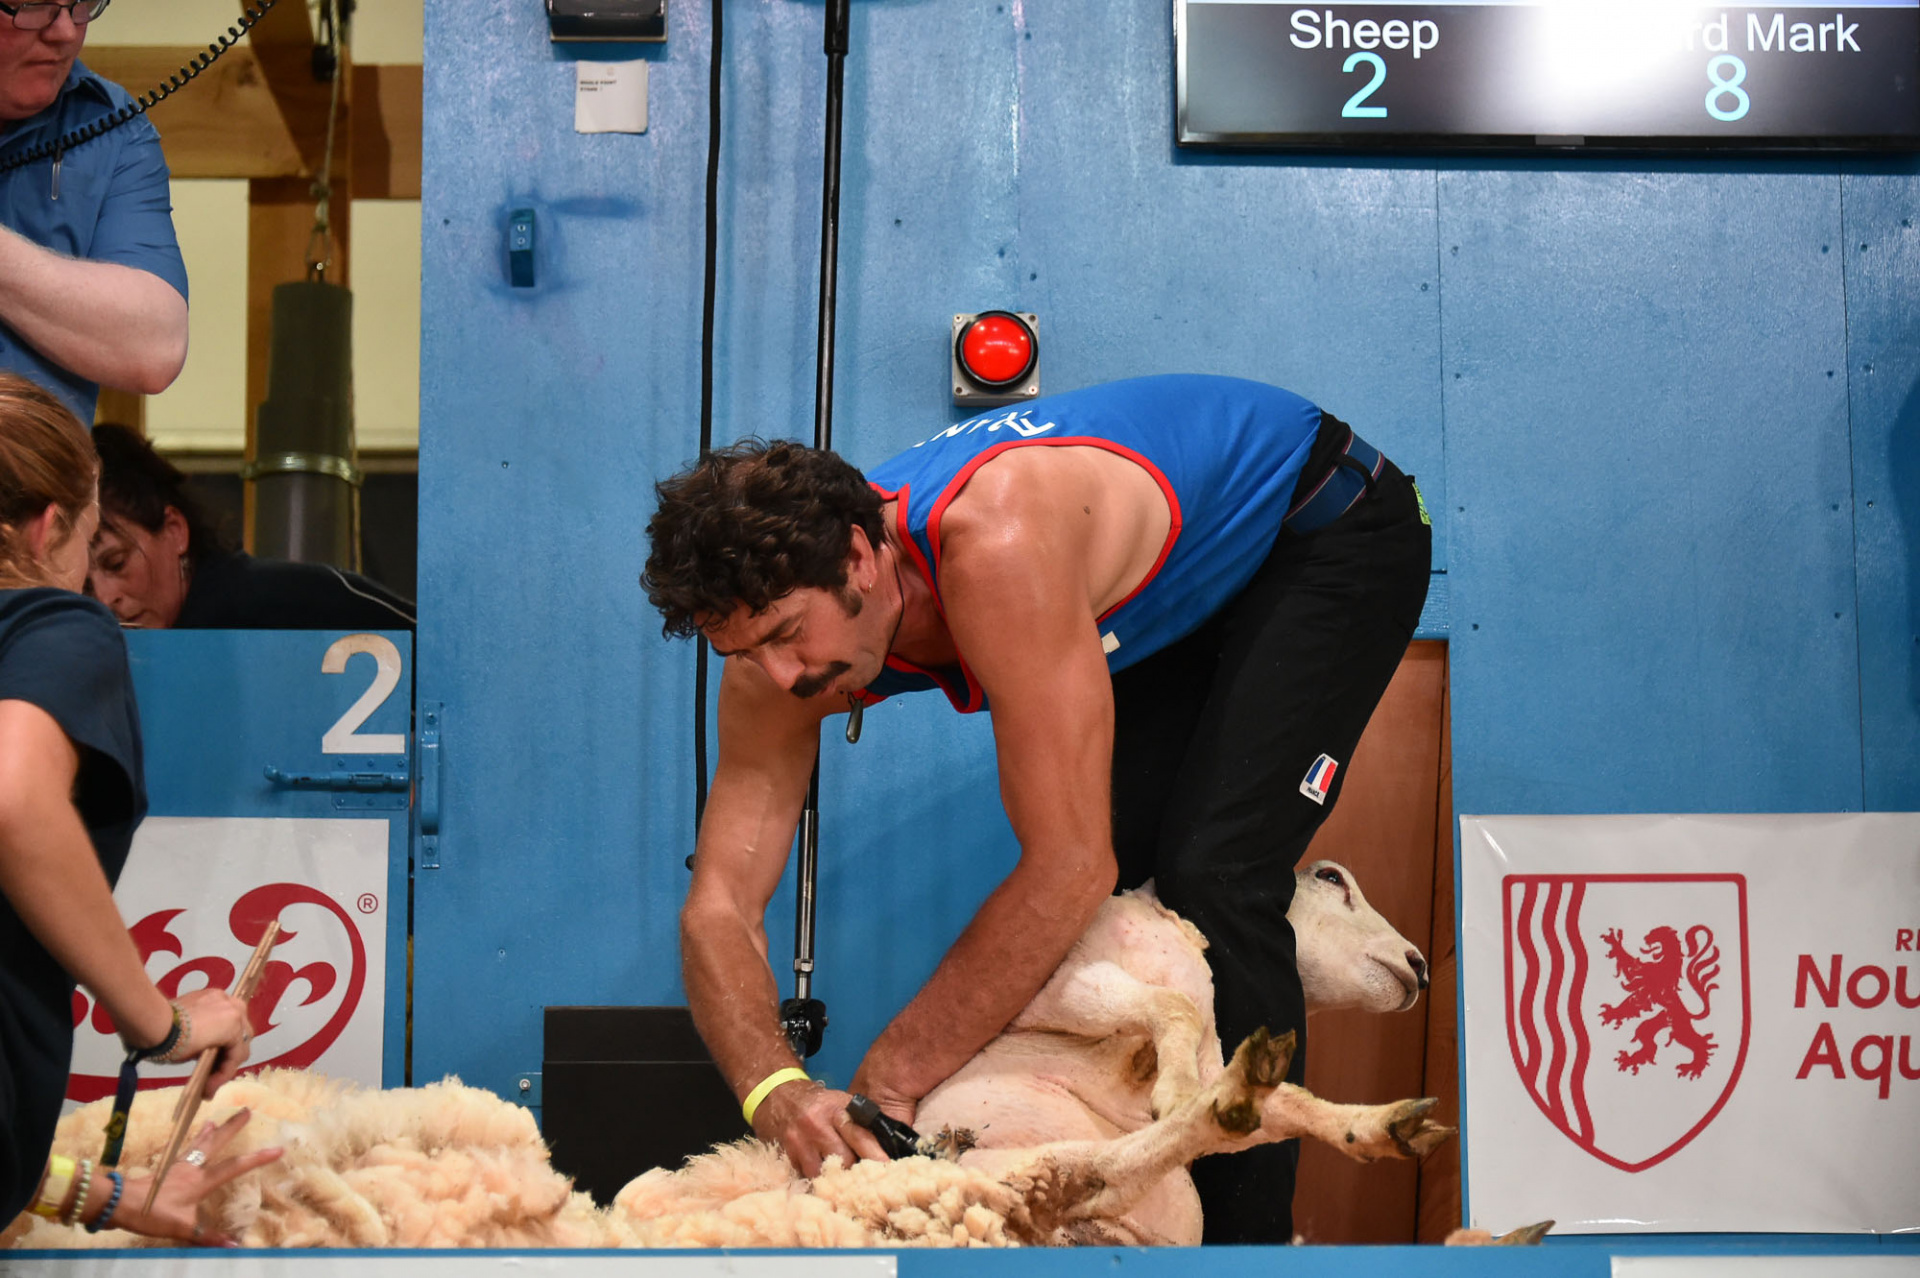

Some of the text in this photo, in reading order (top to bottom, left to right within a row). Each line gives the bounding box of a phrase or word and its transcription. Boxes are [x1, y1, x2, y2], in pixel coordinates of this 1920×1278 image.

[1289, 9, 1440, 59] Sheep
[1746, 13, 1861, 52] Mark
[1341, 51, 1388, 118] 2
[1704, 54, 1750, 122] 8
[322, 633, 405, 754] 2
